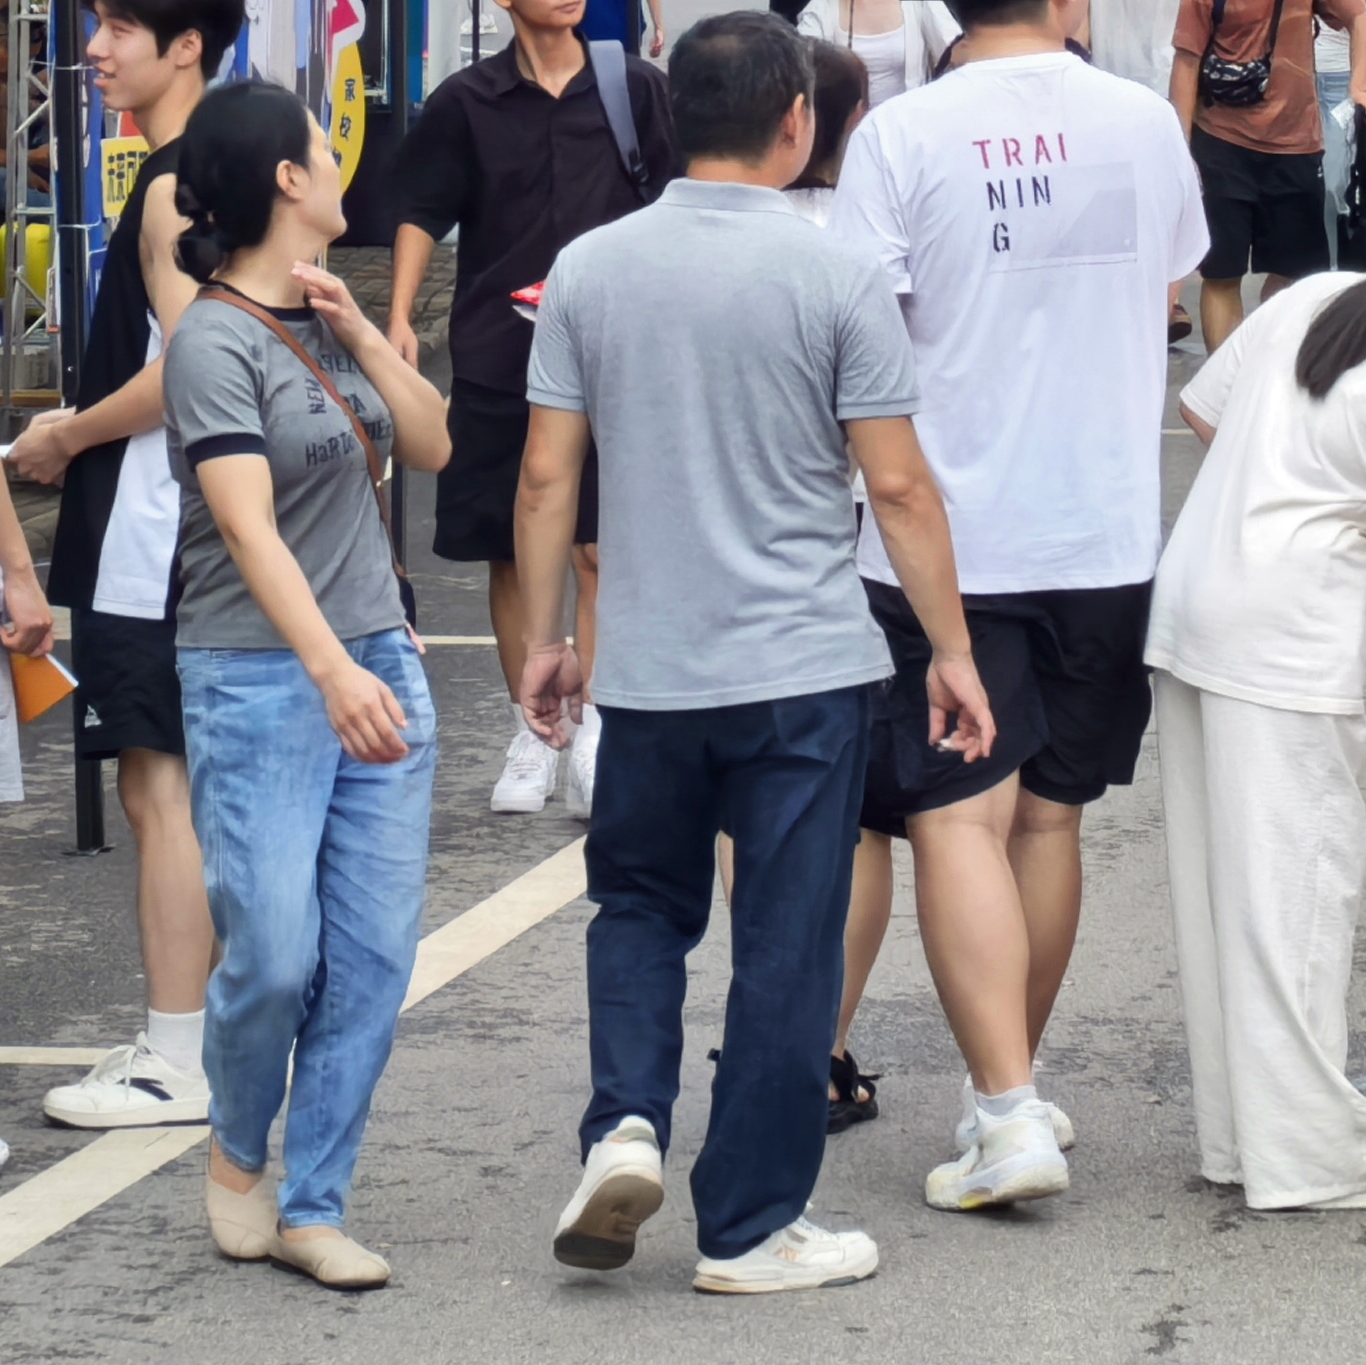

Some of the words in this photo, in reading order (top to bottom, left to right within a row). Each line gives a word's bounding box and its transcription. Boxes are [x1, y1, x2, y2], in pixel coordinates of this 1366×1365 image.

[972, 133, 1067, 169] TRAI
[986, 175, 1052, 211] NIN
[993, 222, 1011, 253] G
